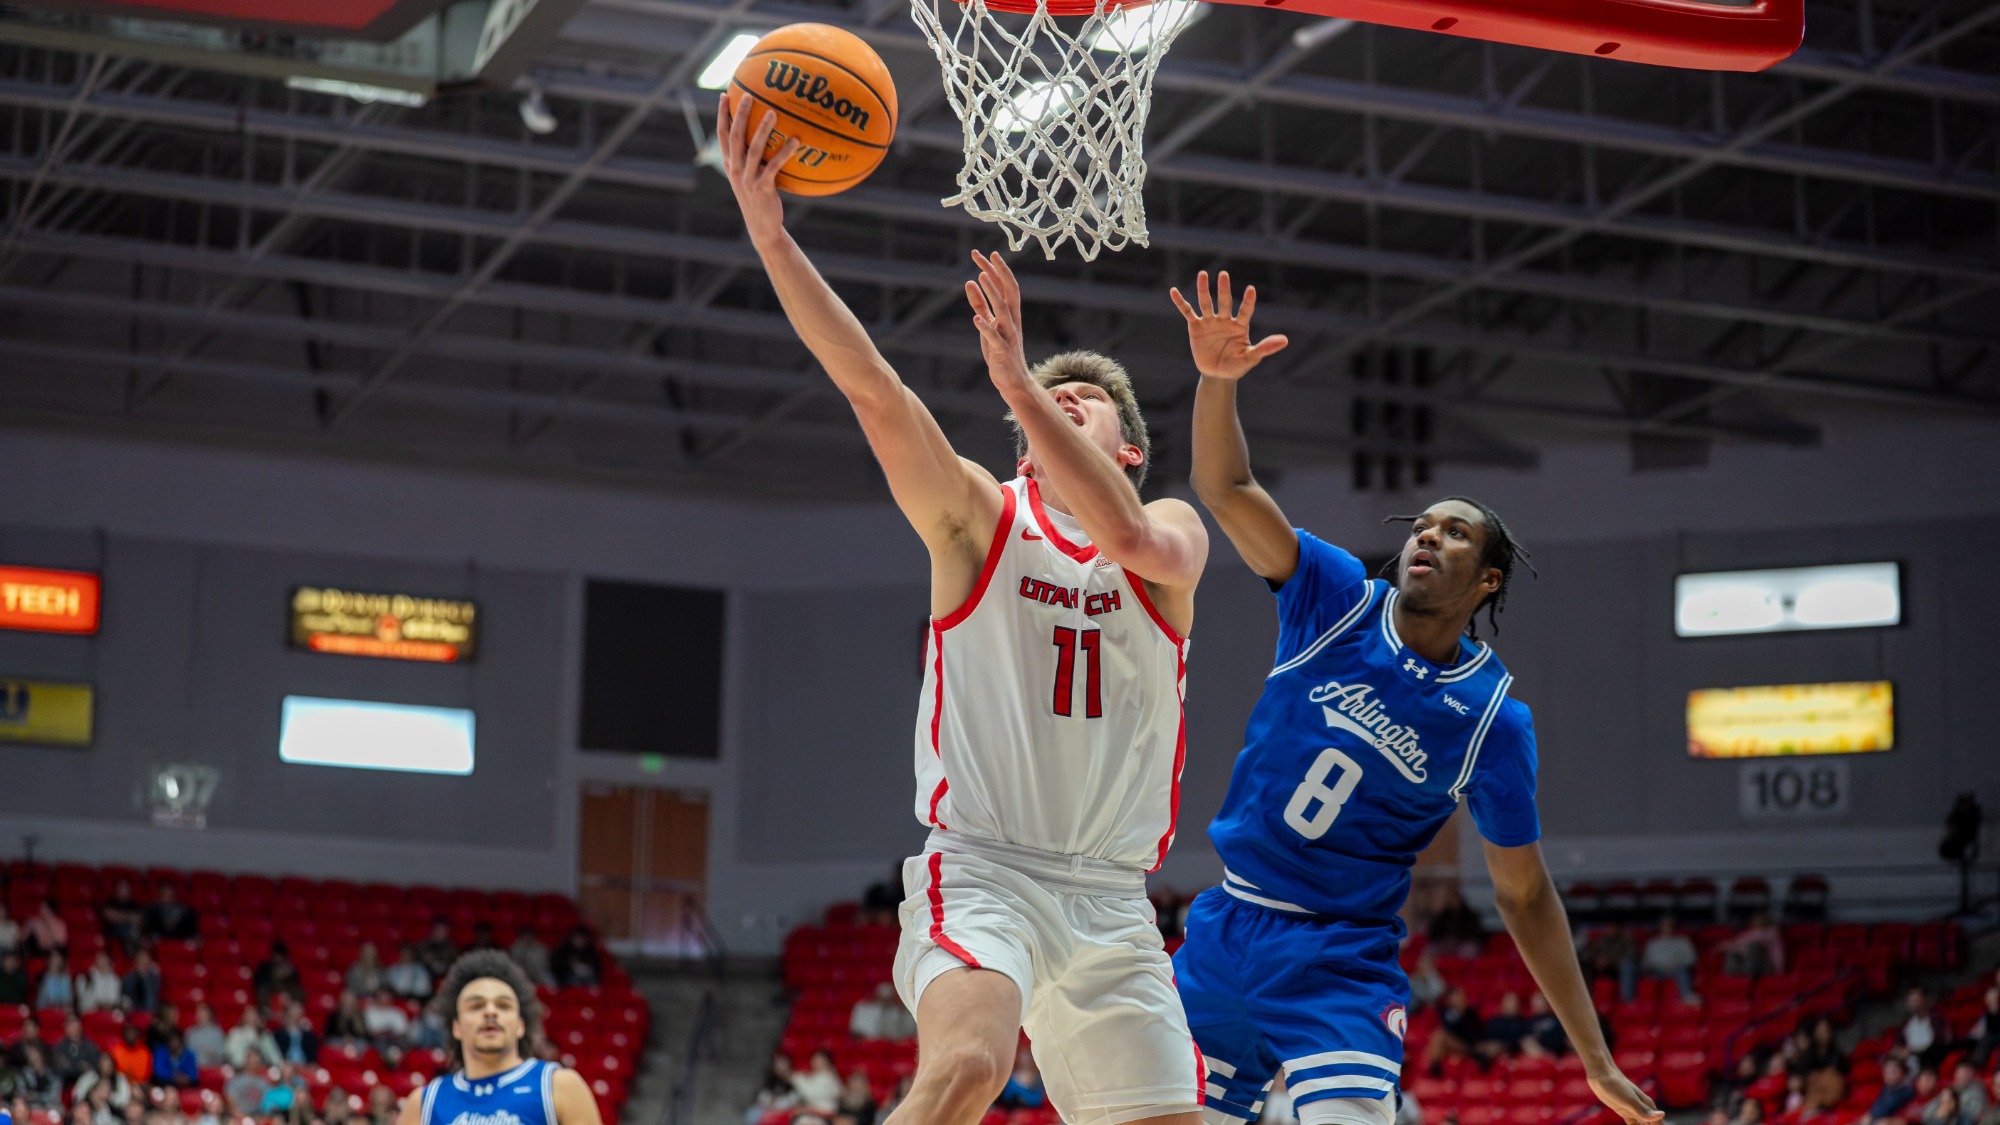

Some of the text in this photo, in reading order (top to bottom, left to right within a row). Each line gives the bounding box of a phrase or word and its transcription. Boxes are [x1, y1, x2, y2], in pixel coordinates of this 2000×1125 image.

[764, 58, 870, 132] Wilson
[766, 128, 829, 167] EO
[2, 583, 80, 617] TECH
[1019, 576, 1122, 616] UTAH CH
[1052, 625, 1103, 719] 11
[1442, 694, 1470, 715] WAC
[1308, 681, 1428, 784] Arlington
[1283, 747, 1364, 840] 8
[1751, 769, 1838, 809] 108
